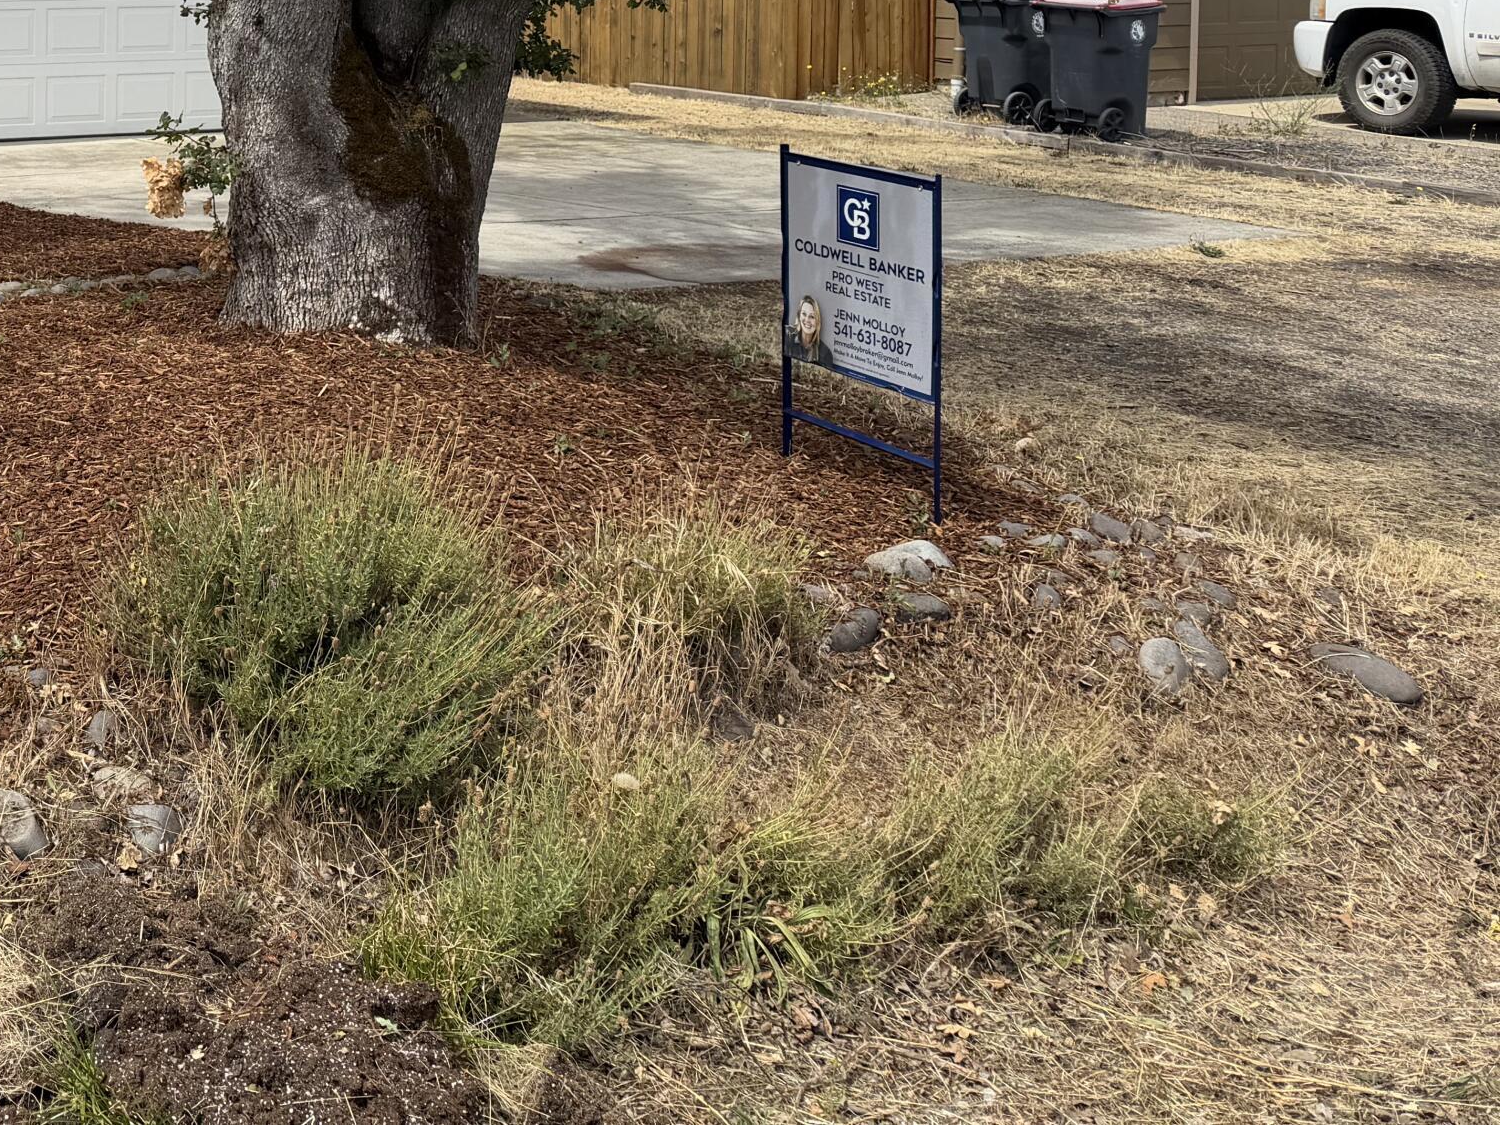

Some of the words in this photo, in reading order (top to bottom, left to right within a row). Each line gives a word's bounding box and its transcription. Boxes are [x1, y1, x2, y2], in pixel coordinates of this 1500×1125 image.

[794, 238, 865, 268] COLDWELL
[869, 257, 925, 284] BANKER
[825, 281, 851, 298] REAL
[854, 289, 891, 309] ESTATE
[832, 271, 853, 285] PRO
[855, 276, 884, 293] WEST
[834, 308, 860, 324] JENN
[863, 316, 906, 337] MOLLOY
[833, 321, 913, 356] 541-631-8087
